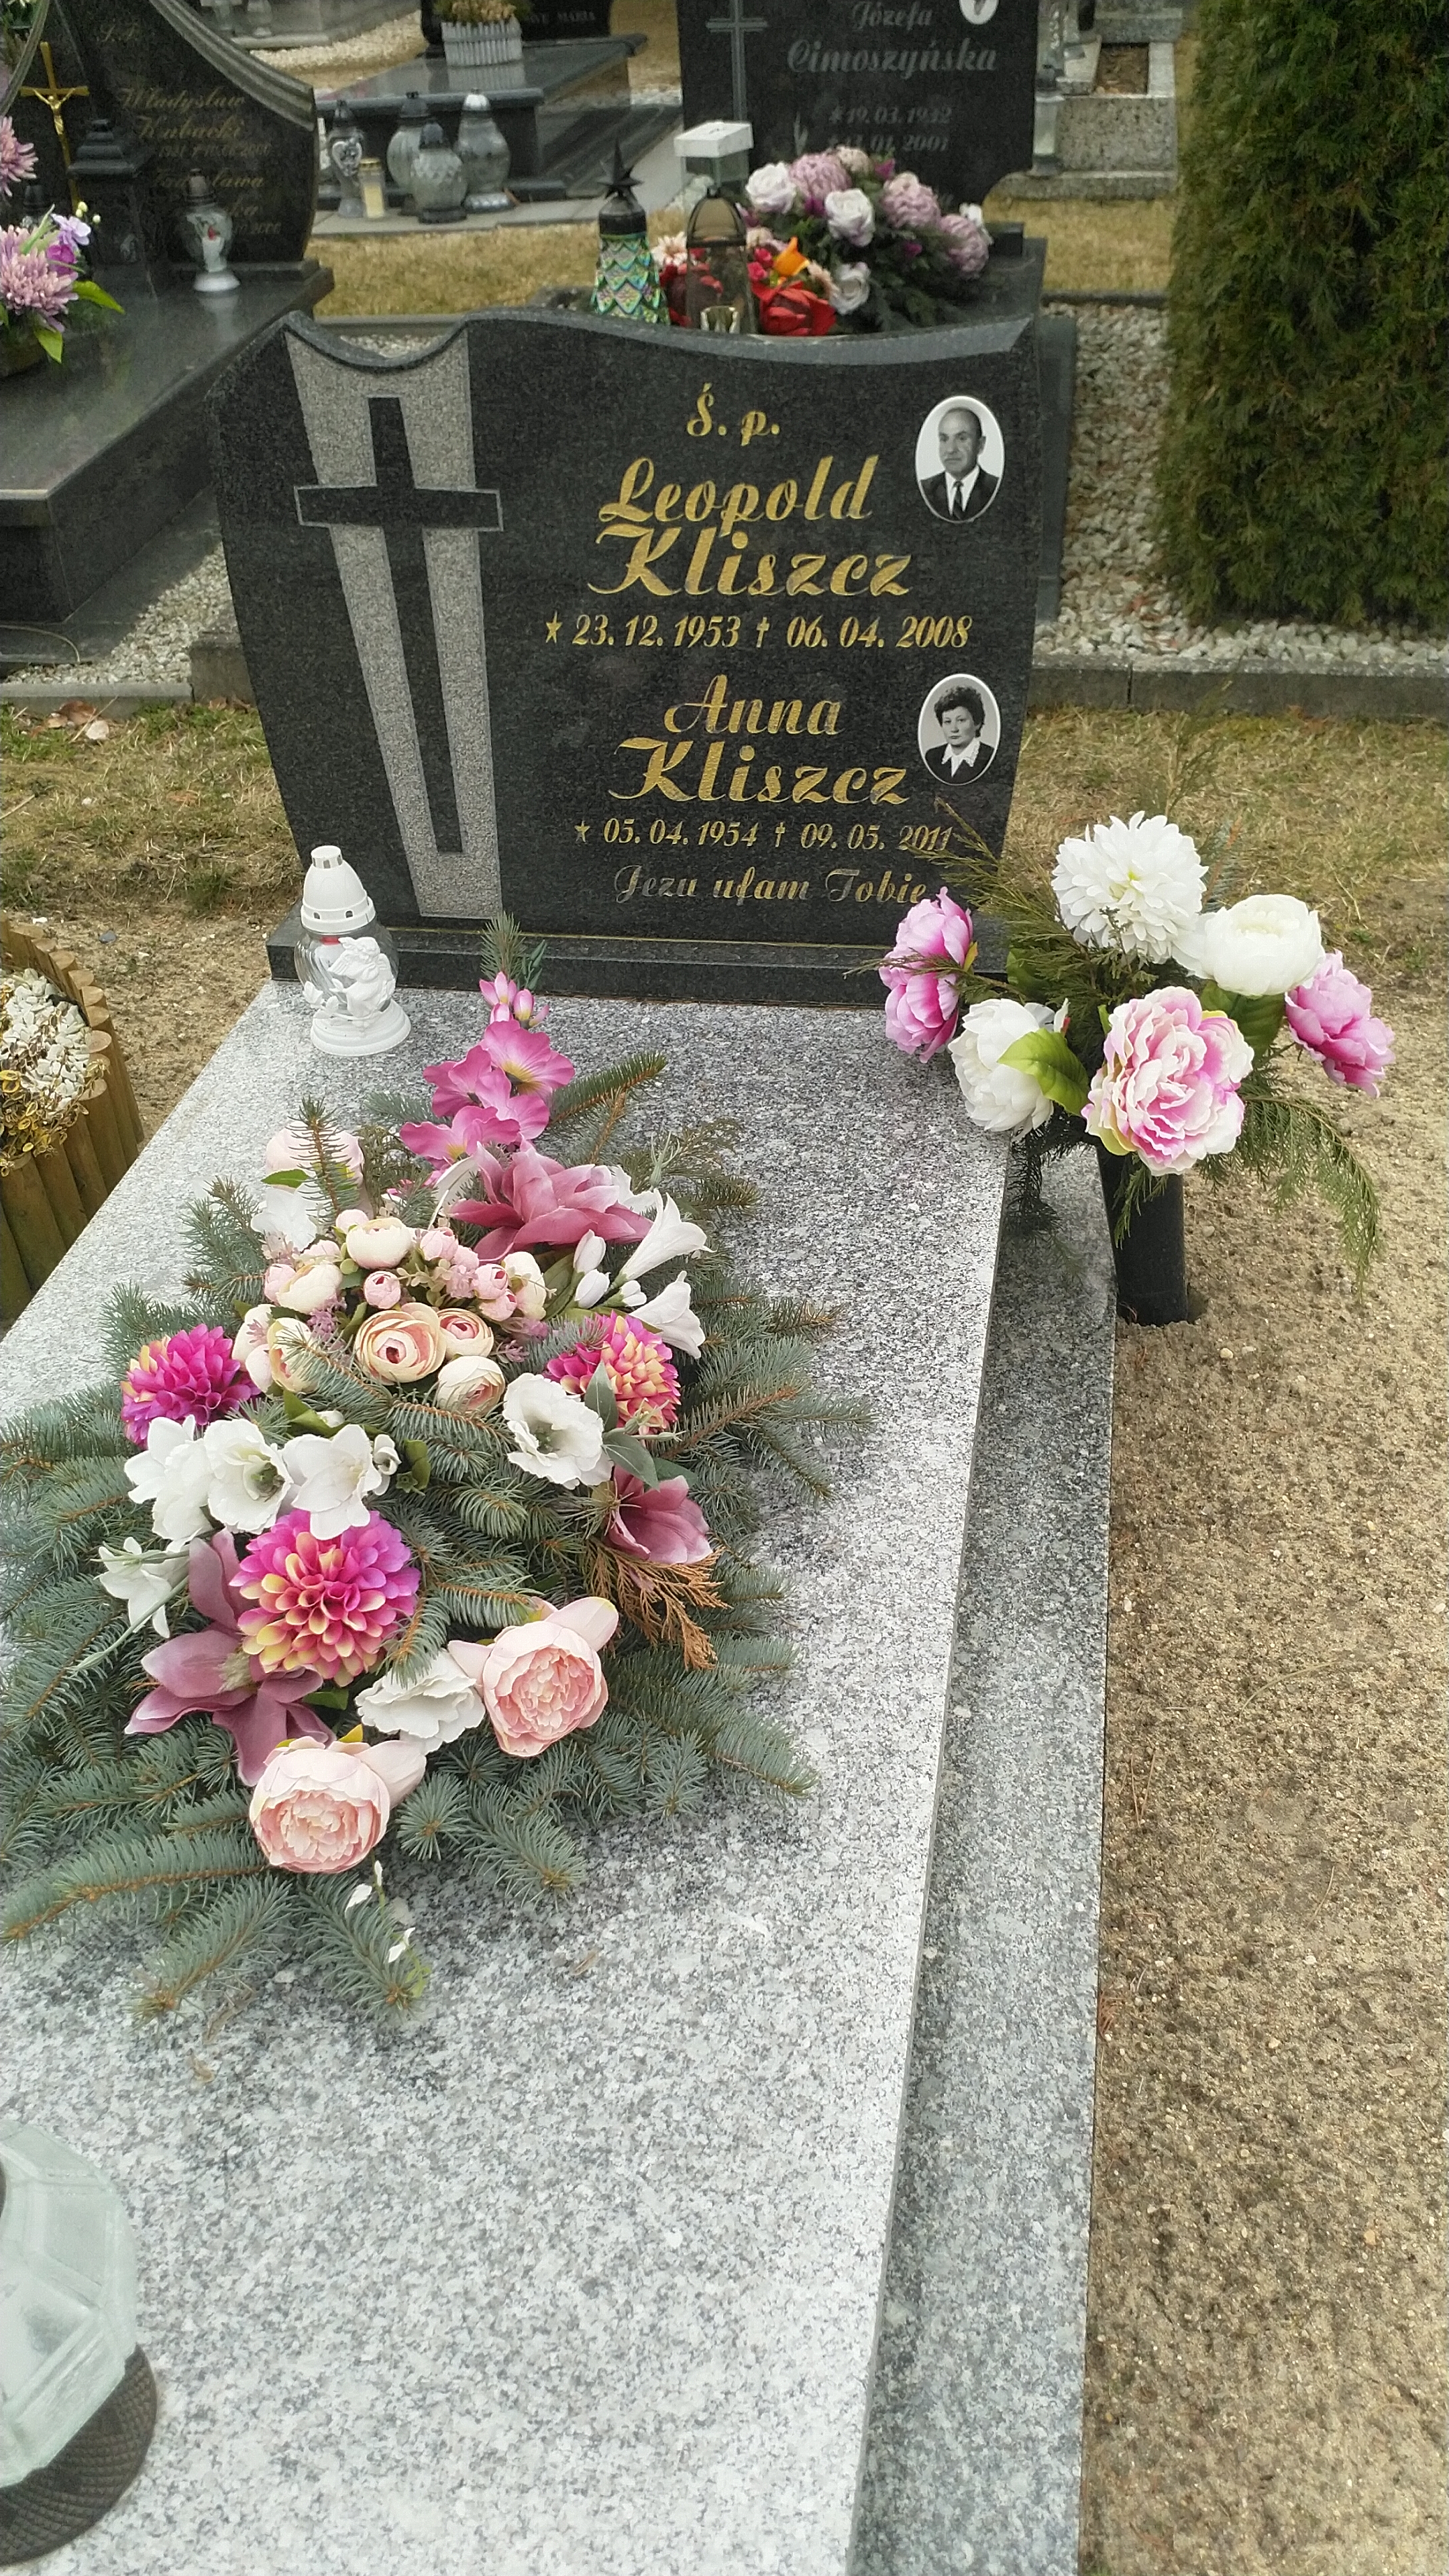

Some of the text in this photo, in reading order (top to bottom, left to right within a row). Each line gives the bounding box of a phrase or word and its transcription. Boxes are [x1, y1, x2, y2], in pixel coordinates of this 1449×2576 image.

[852, 2, 933, 31] Józefa
[787, 38, 997, 79] Cimoszyńska
[687, 383, 780, 446] Ś. p.
[598, 455, 879, 537] Leopold
[588, 524, 912, 596] Kliszcz
[664, 674, 843, 736] Anna
[608, 737, 910, 805] Kliszcz
[614, 865, 927, 906] Jezu ufam Tobie
